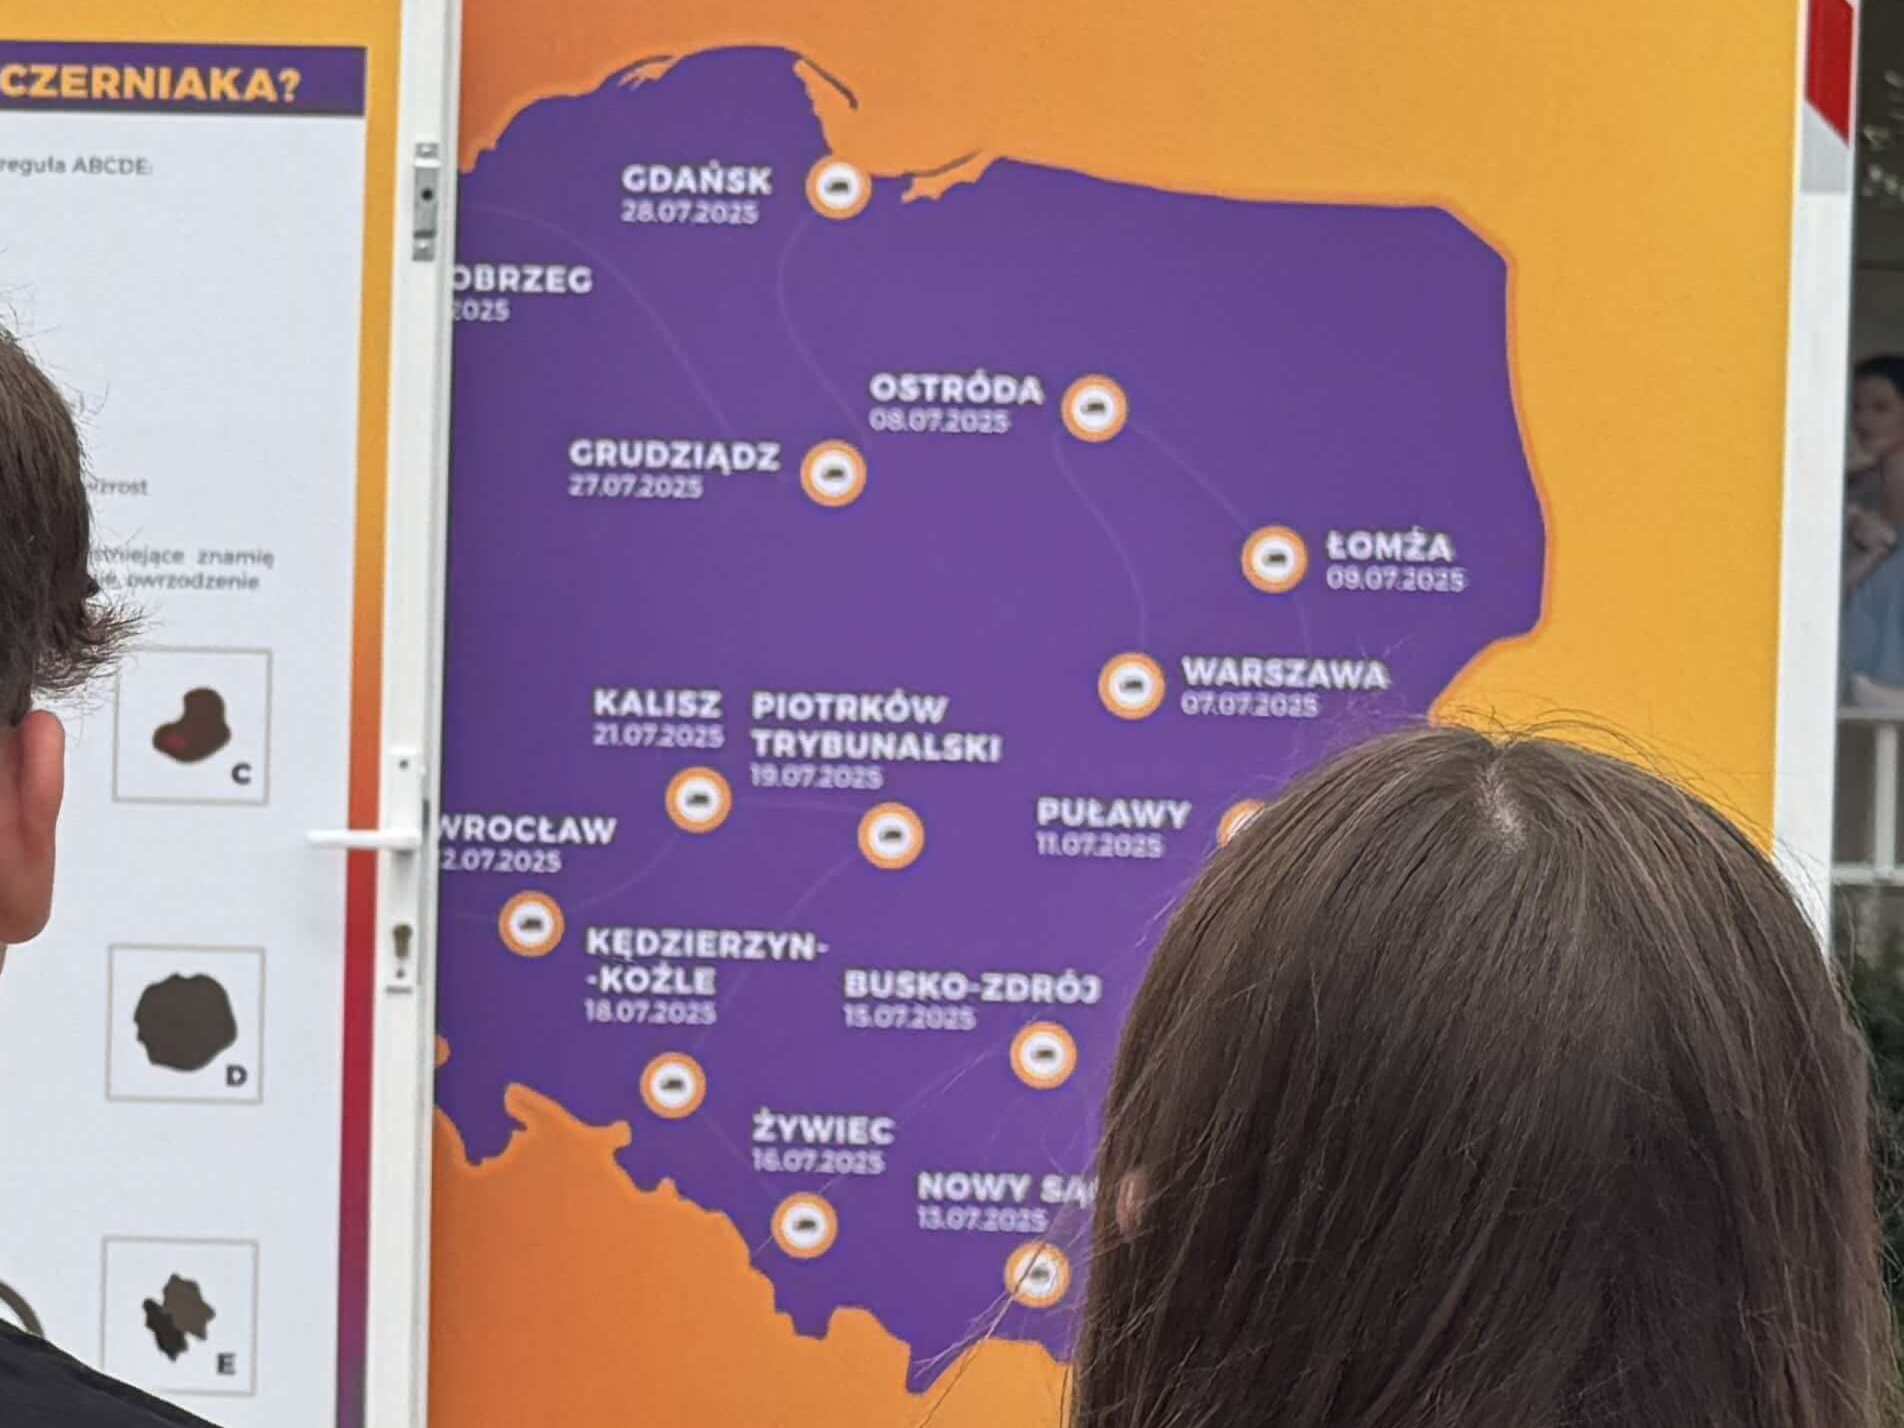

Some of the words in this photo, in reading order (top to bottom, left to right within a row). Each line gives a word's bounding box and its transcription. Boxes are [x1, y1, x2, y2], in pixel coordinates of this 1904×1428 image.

[622, 159, 773, 196] GDAŃSK
[621, 201, 759, 224] 28.07.2025
[869, 369, 1044, 406] OSTRÓDA
[869, 408, 1010, 433] 08.07.2025
[568, 439, 781, 476] GRUDZIĄDZ
[568, 475, 703, 499] 27.07.2025
[1326, 526, 1455, 563] ŁOMŻA
[1182, 655, 1390, 690] WARSZAWA
[594, 689, 723, 719] KALISZ
[751, 687, 950, 725] PIOTRKÓW
[1181, 691, 1319, 718] 07.07.2025
[593, 723, 724, 749] 21.07.2025
[751, 728, 1003, 763] TRYBUNALSKI
[231, 761, 253, 785] C
[750, 763, 883, 790] 19.07.2025
[440, 813, 618, 844] WROCŁAW
[1037, 796, 1191, 830] PUŁAWY
[441, 847, 562, 873] 2.07.2025
[1036, 830, 1164, 859] 11.07.2025
[586, 927, 829, 964] KĘDZIERZYN-
[844, 967, 1102, 1005] BUSKO-ZDRÓJ
[225, 1064, 248, 1088] D
[752, 1107, 895, 1146] ŻYWIEC
[918, 1172, 1031, 1203] NOWY
[216, 1351, 236, 1375] E
